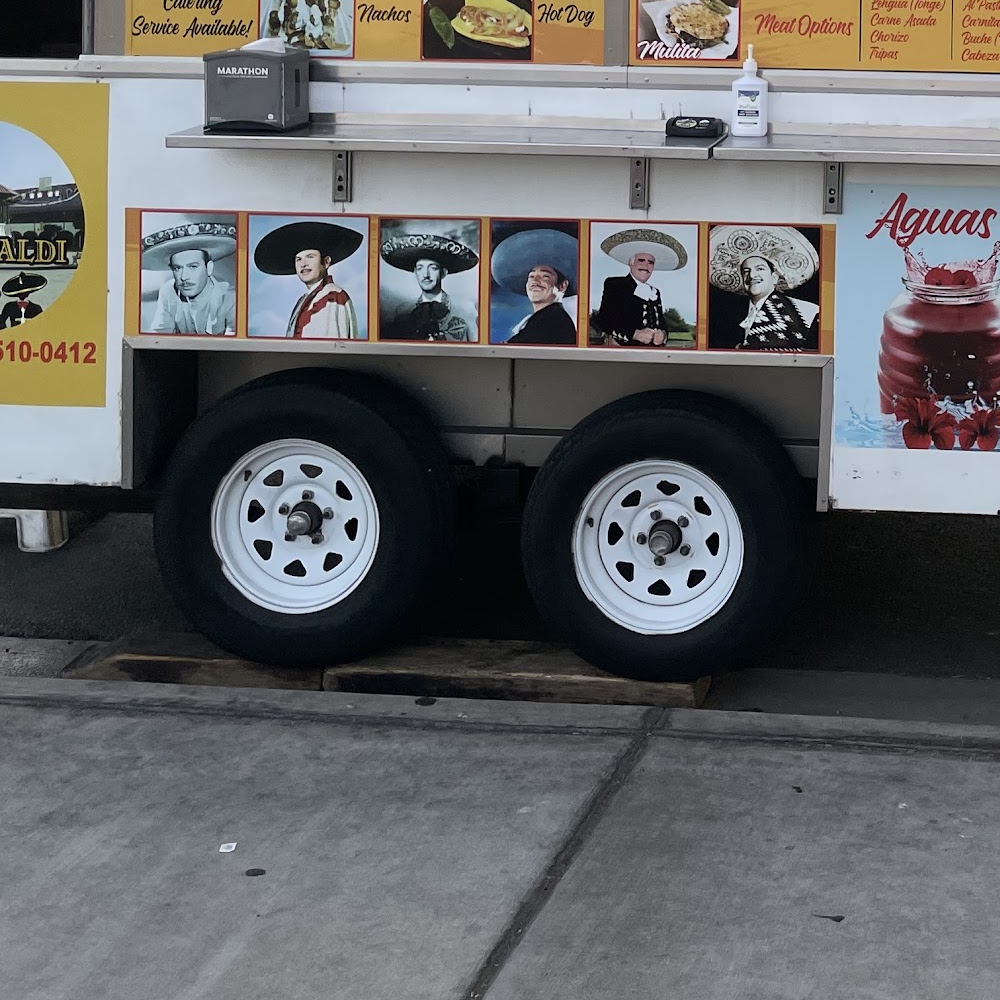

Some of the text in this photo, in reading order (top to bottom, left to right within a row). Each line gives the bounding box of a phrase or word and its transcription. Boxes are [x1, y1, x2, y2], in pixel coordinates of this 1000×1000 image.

[358, 3, 412, 24] Nachos
[537, 3, 595, 28] Hot Dog
[870, 13, 937, 28] Carne Asada
[131, 15, 253, 39] Service Available!
[754, 13, 854, 39] Meat Options
[870, 29, 910, 43] Chorizo
[961, 31, 993, 46] Buche
[637, 40, 701, 60] Mulita
[869, 46, 899, 61] Tripas
[961, 48, 1000, 63] Cabeza
[217, 66, 269, 76] MARATHON
[865, 192, 997, 248] Aguas
